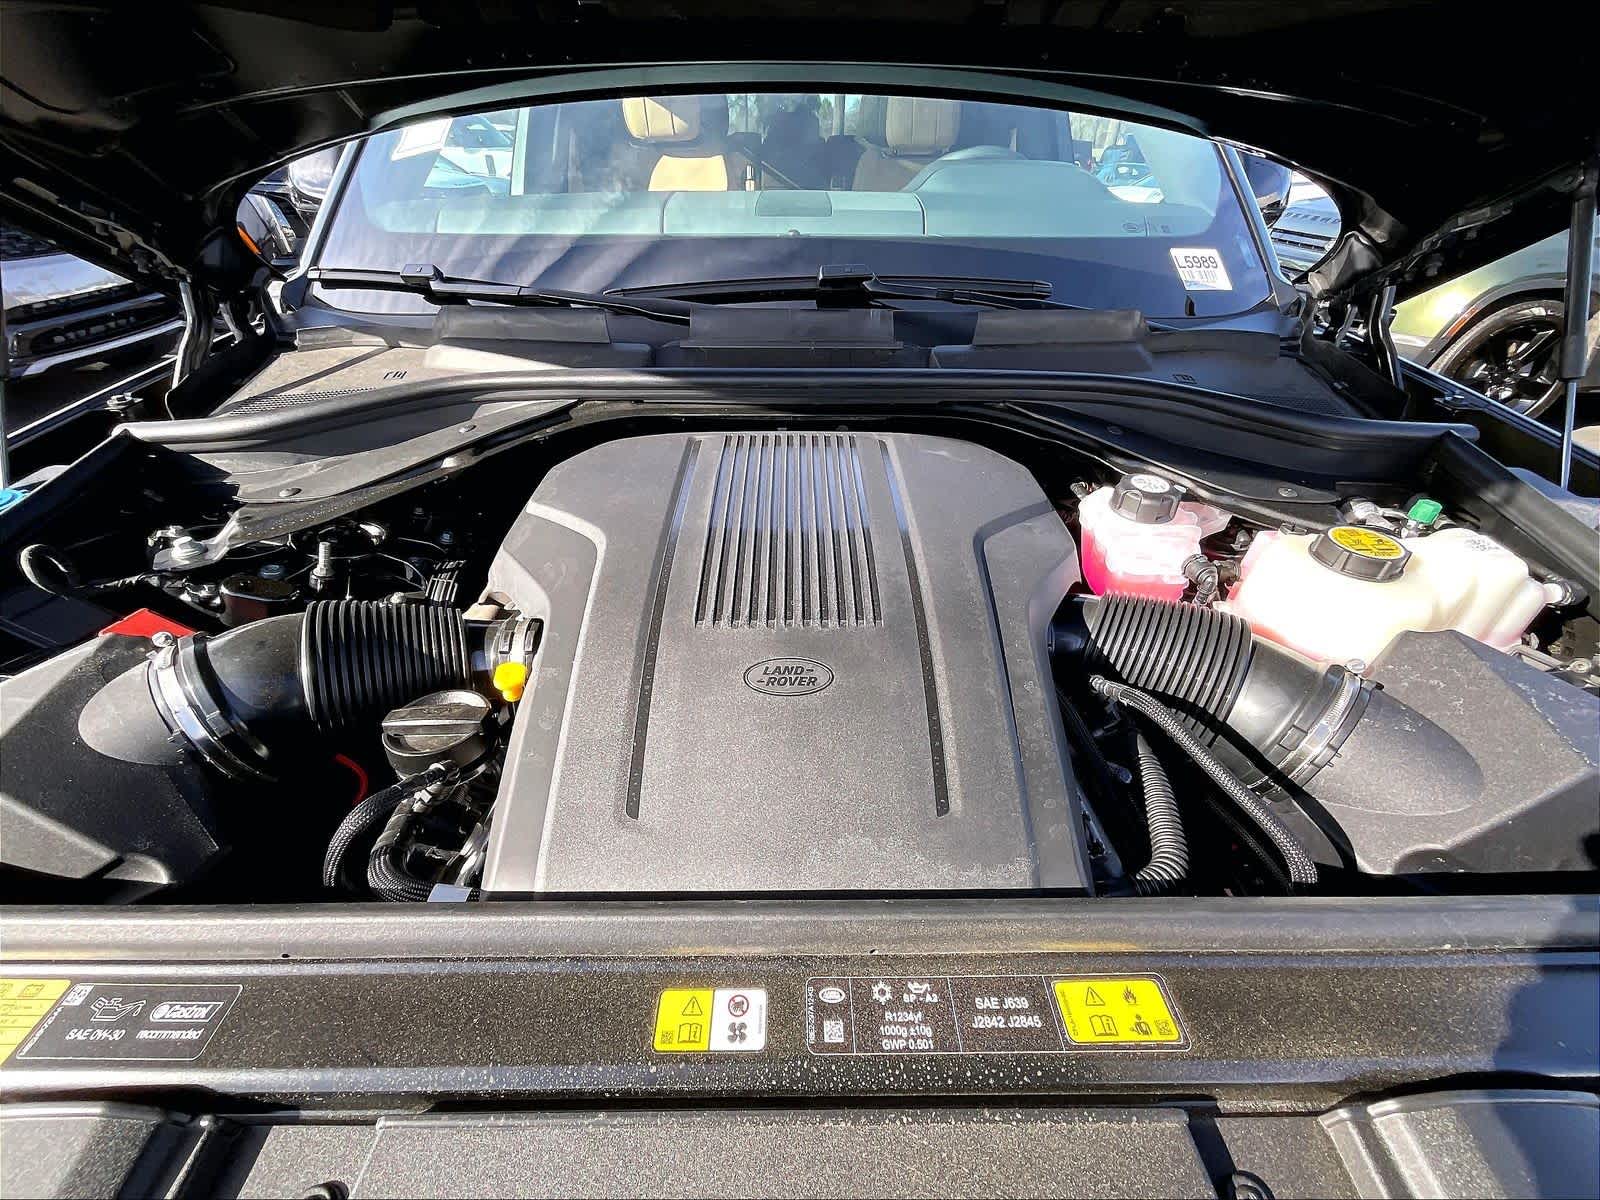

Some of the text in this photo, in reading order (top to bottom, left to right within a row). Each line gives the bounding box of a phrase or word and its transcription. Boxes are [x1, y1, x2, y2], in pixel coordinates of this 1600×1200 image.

[1174, 255, 1218, 269] L5989
[975, 997, 1029, 1010] SAE J639
[166, 1005, 210, 1018] Castrol
[884, 1011, 923, 1023] R1234yf
[971, 1015, 1043, 1029] J2842 J2845
[65, 1028, 90, 1041] SAE
[135, 1028, 205, 1041] recommended
[879, 1025, 908, 1038] 1000g
[881, 1039, 907, 1050] GWP
